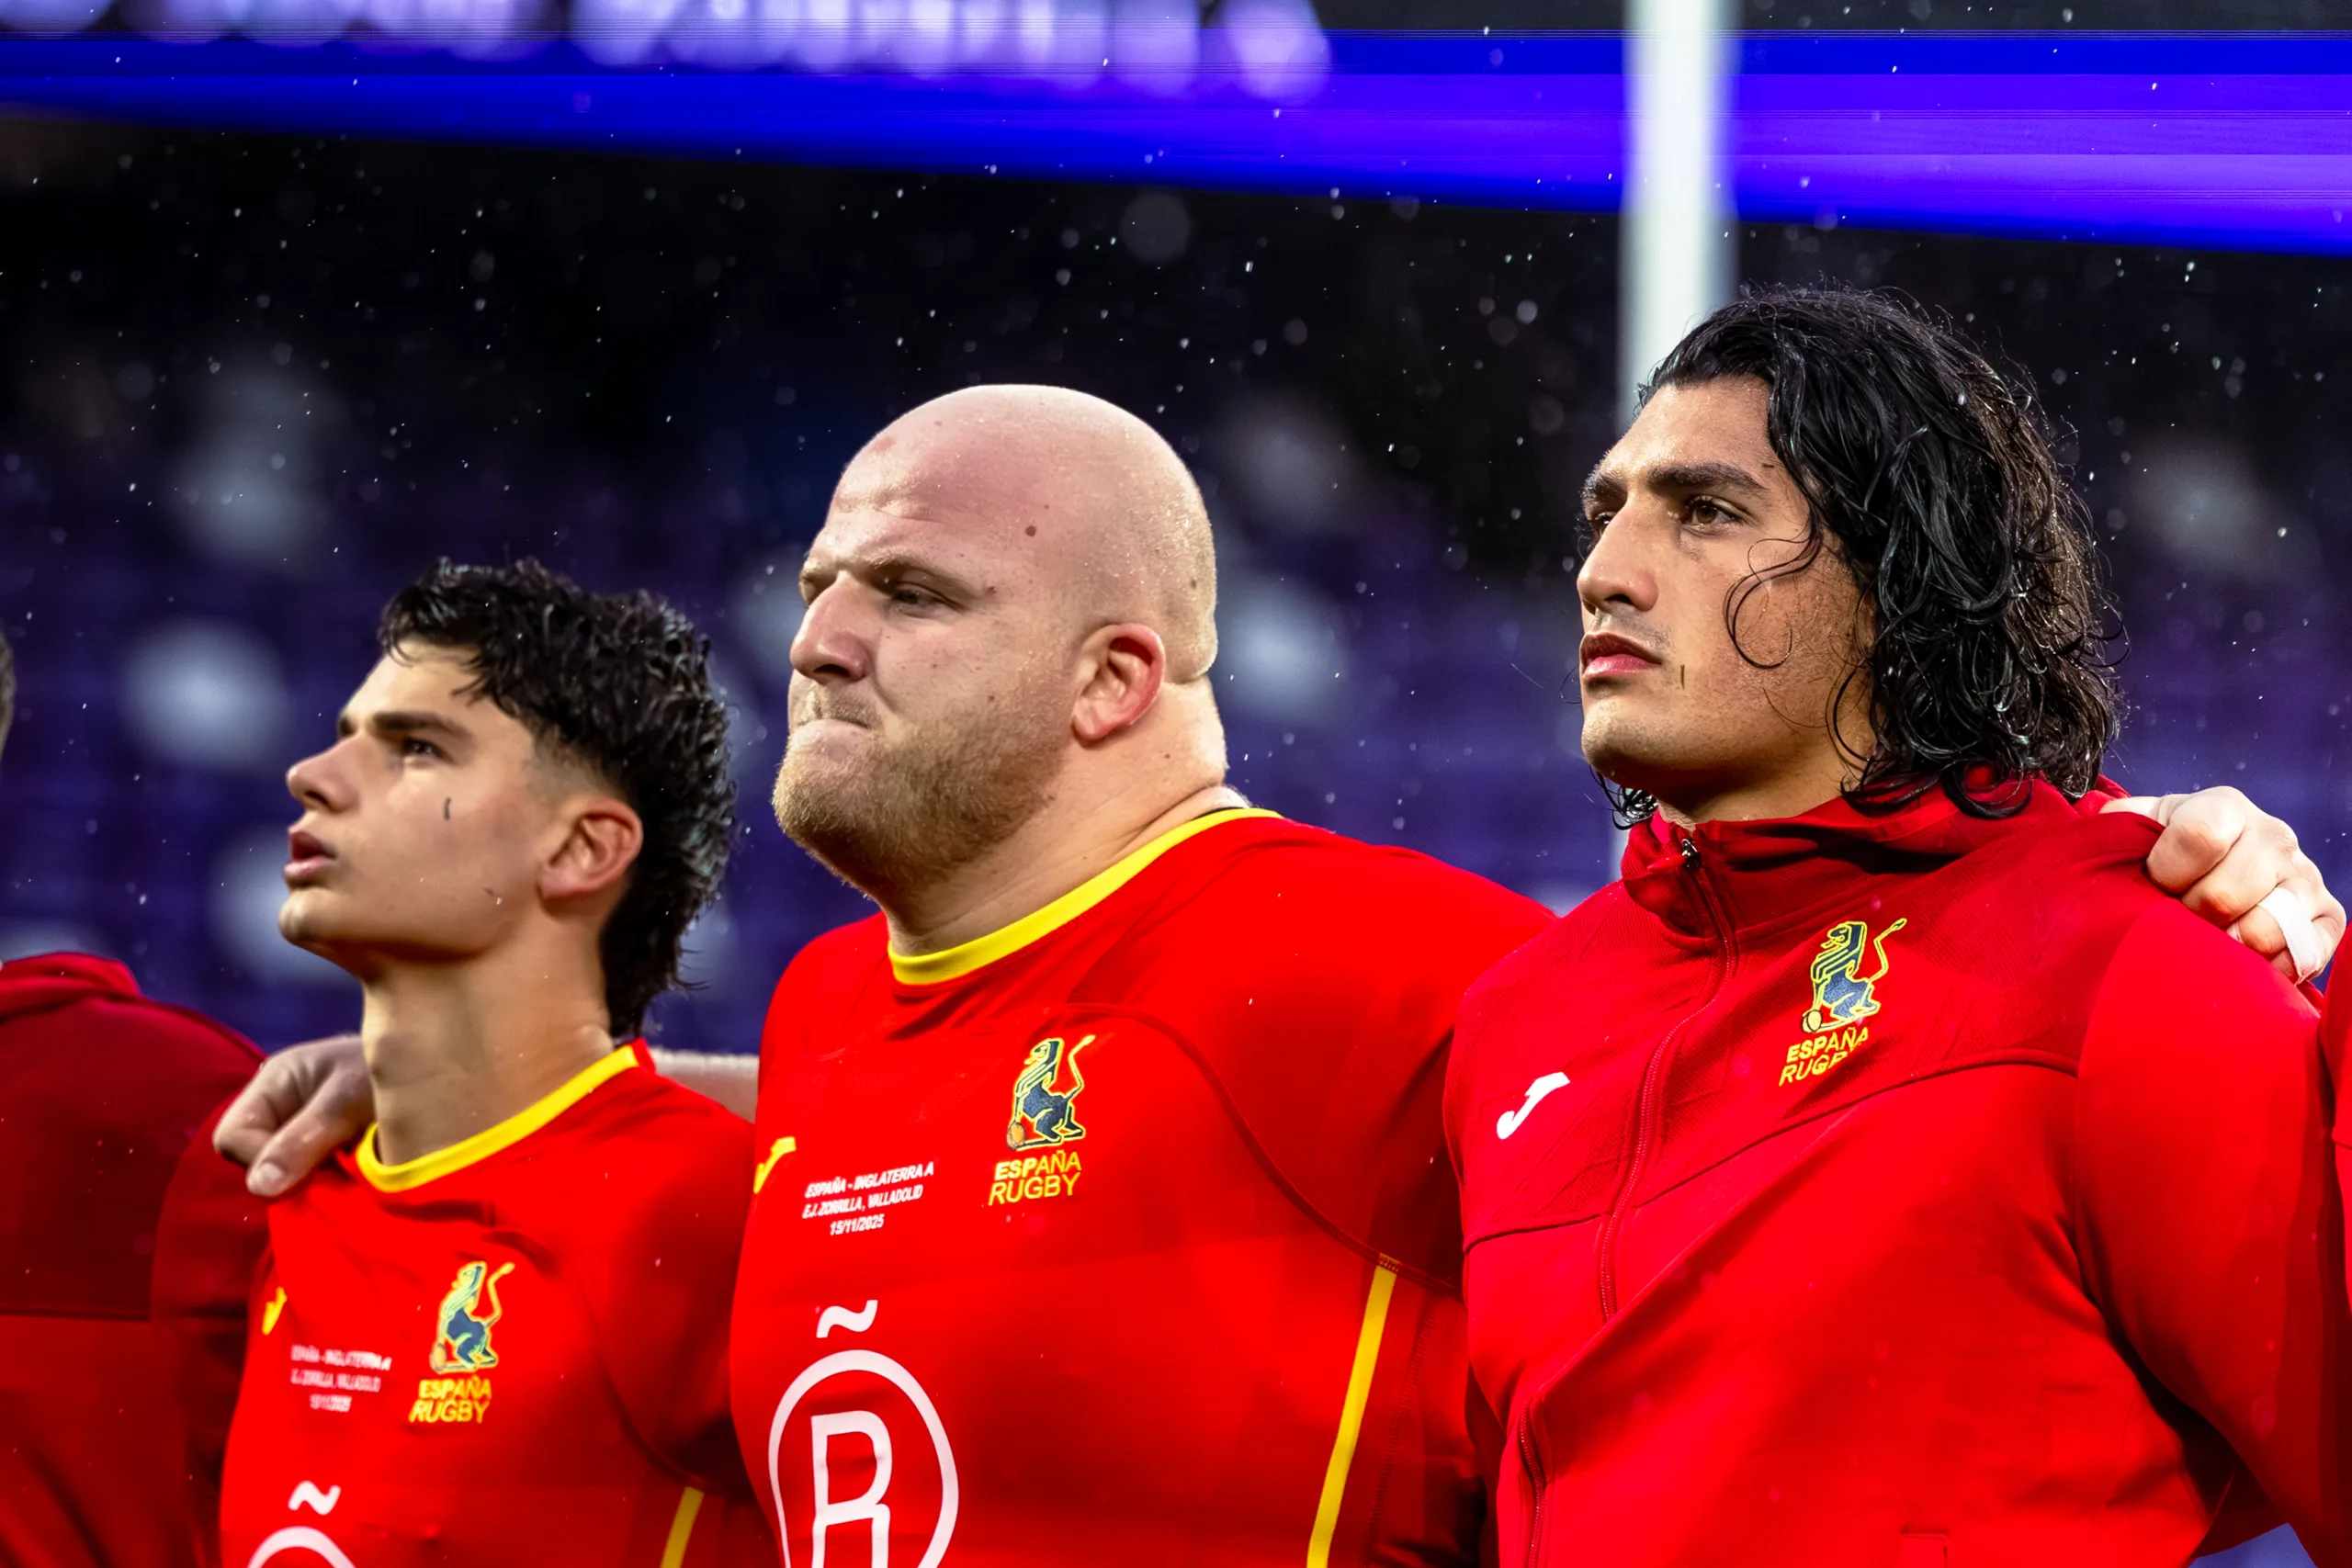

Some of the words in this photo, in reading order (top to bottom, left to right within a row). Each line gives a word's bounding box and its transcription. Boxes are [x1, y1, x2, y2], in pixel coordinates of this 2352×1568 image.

[1786, 1026, 1869, 1064] ESPAÑA
[994, 1149, 1082, 1181] ESPAÑA
[804, 1176, 846, 1199] ESPAÑA
[854, 1164, 923, 1190] INGLATERRA
[923, 1161, 934, 1177] A
[988, 1171, 1081, 1206] RUGBY
[867, 1184, 923, 1209] VALLADOLID
[830, 1213, 885, 1236] 15/11/2025
[418, 1373, 492, 1400] ESPAÑA
[407, 1399, 491, 1424] RUGBY
